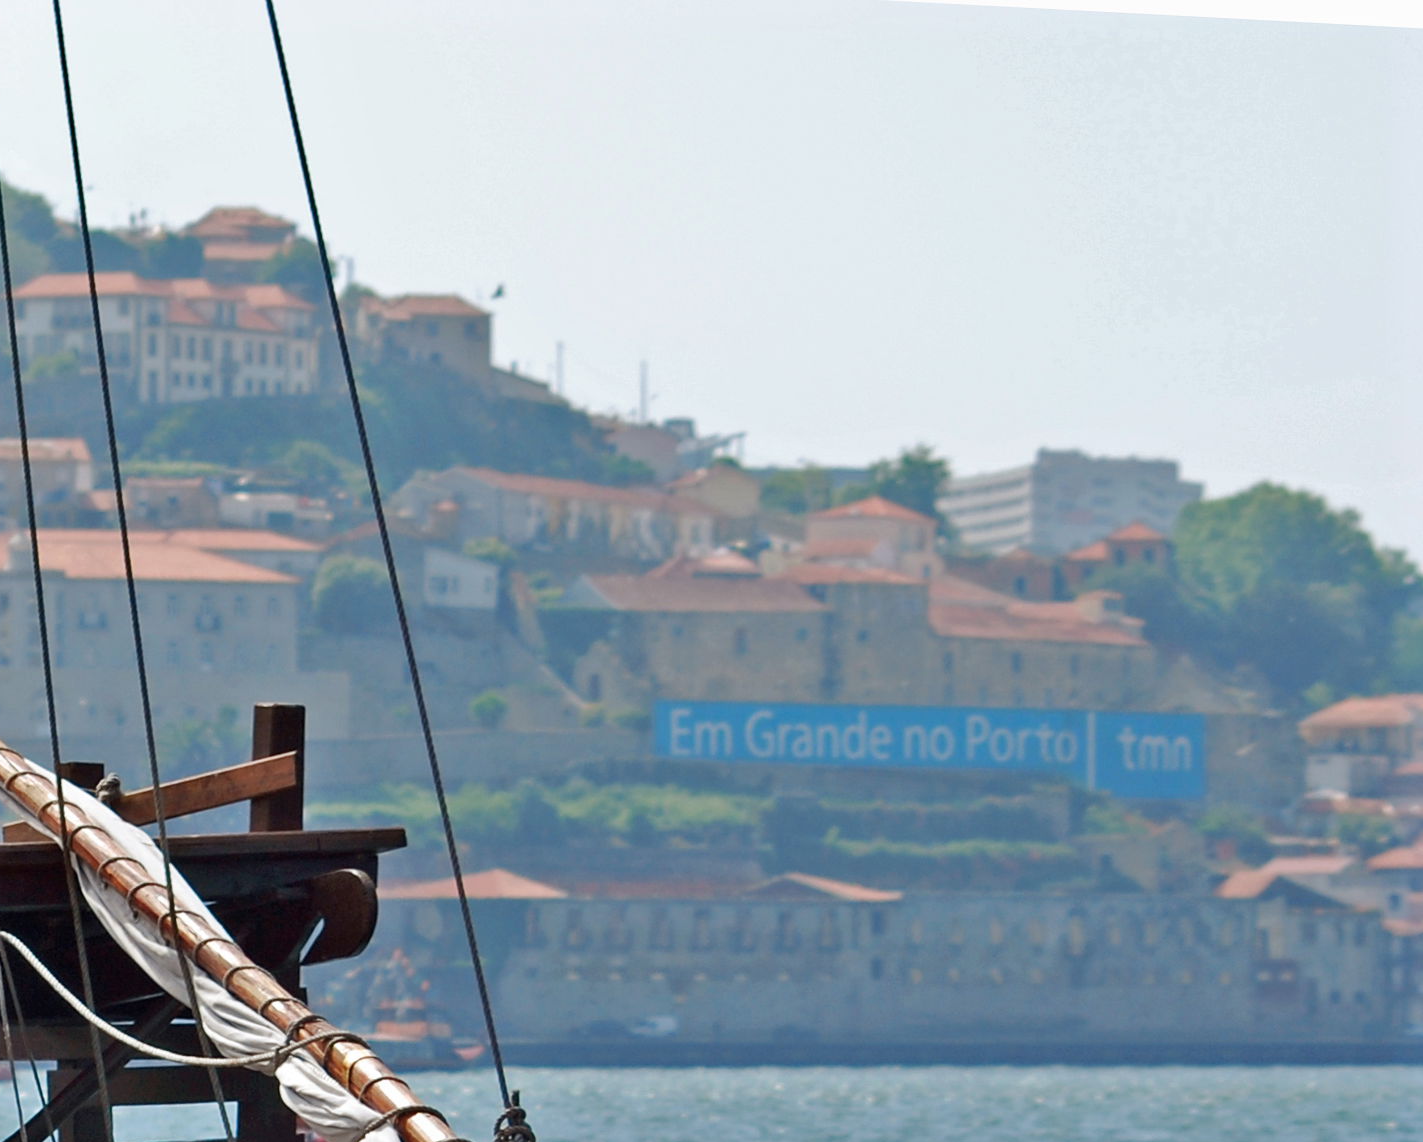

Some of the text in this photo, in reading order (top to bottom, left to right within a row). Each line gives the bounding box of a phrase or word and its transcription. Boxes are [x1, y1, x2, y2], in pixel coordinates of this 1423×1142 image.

[669, 708, 1076, 764] Em Grande no Porto
[1117, 725, 1194, 771] tmn
